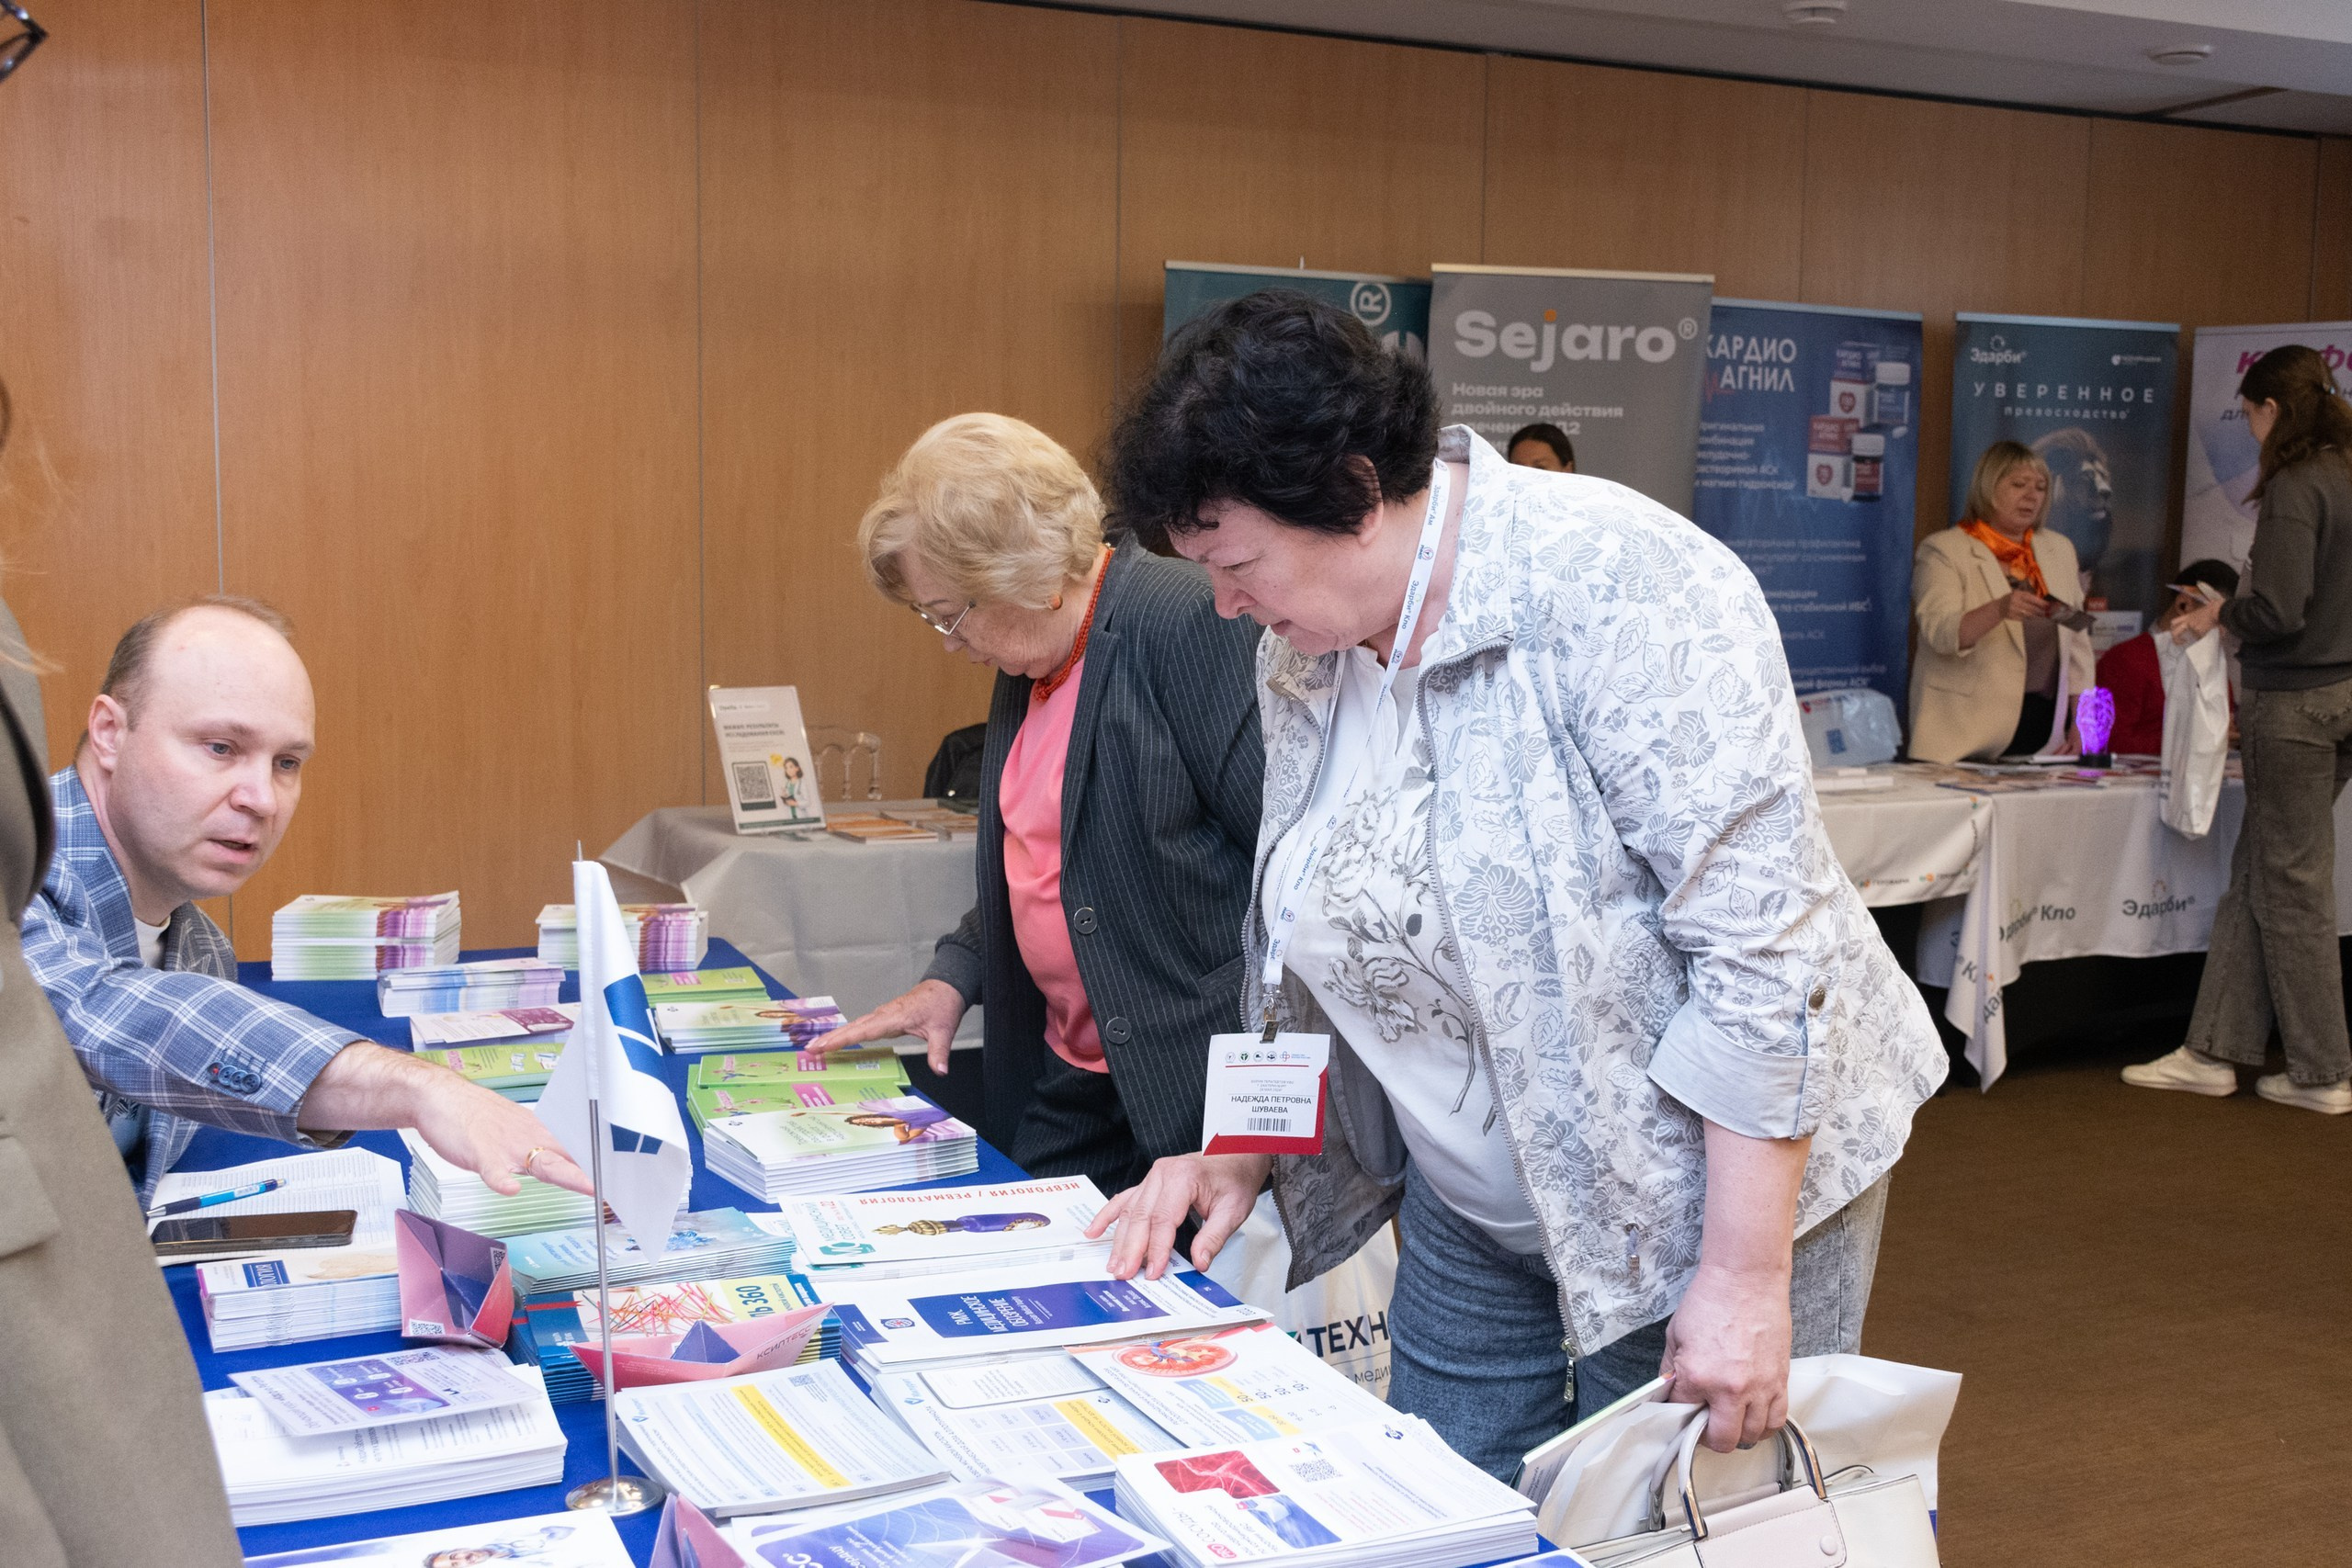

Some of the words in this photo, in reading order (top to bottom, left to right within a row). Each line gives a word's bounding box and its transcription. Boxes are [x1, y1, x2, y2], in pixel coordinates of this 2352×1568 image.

[1451, 382, 1508, 398] Новая
[1510, 385, 1544, 400] эра
[1973, 381, 2154, 404] УВЕРЕННОЕ
[1451, 400, 1537, 417] двойного
[1538, 402, 1624, 418] действия
[1401, 614, 1411, 630] Кло
[1294, 875, 1306, 891] Кло
[2041, 903, 2076, 922] Кло
[2121, 894, 2195, 919] Эдарби®
[1271, 1096, 1312, 1104] ПЕТРОВНА
[859, 1190, 974, 1205] РЕВМАТОЛОГИЯ
[989, 1181, 1080, 1197] НЕВРОЛОГИЯ
[735, 1285, 769, 1306] 360
[960, 1295, 1010, 1333] МЕДИЦИНСКОЕ
[988, 1297, 1029, 1326] ОБОЗРЕНИЕ
[756, 1324, 812, 1360] КСИЛТЕСС
[1306, 1311, 1389, 1358] ТЕХН
